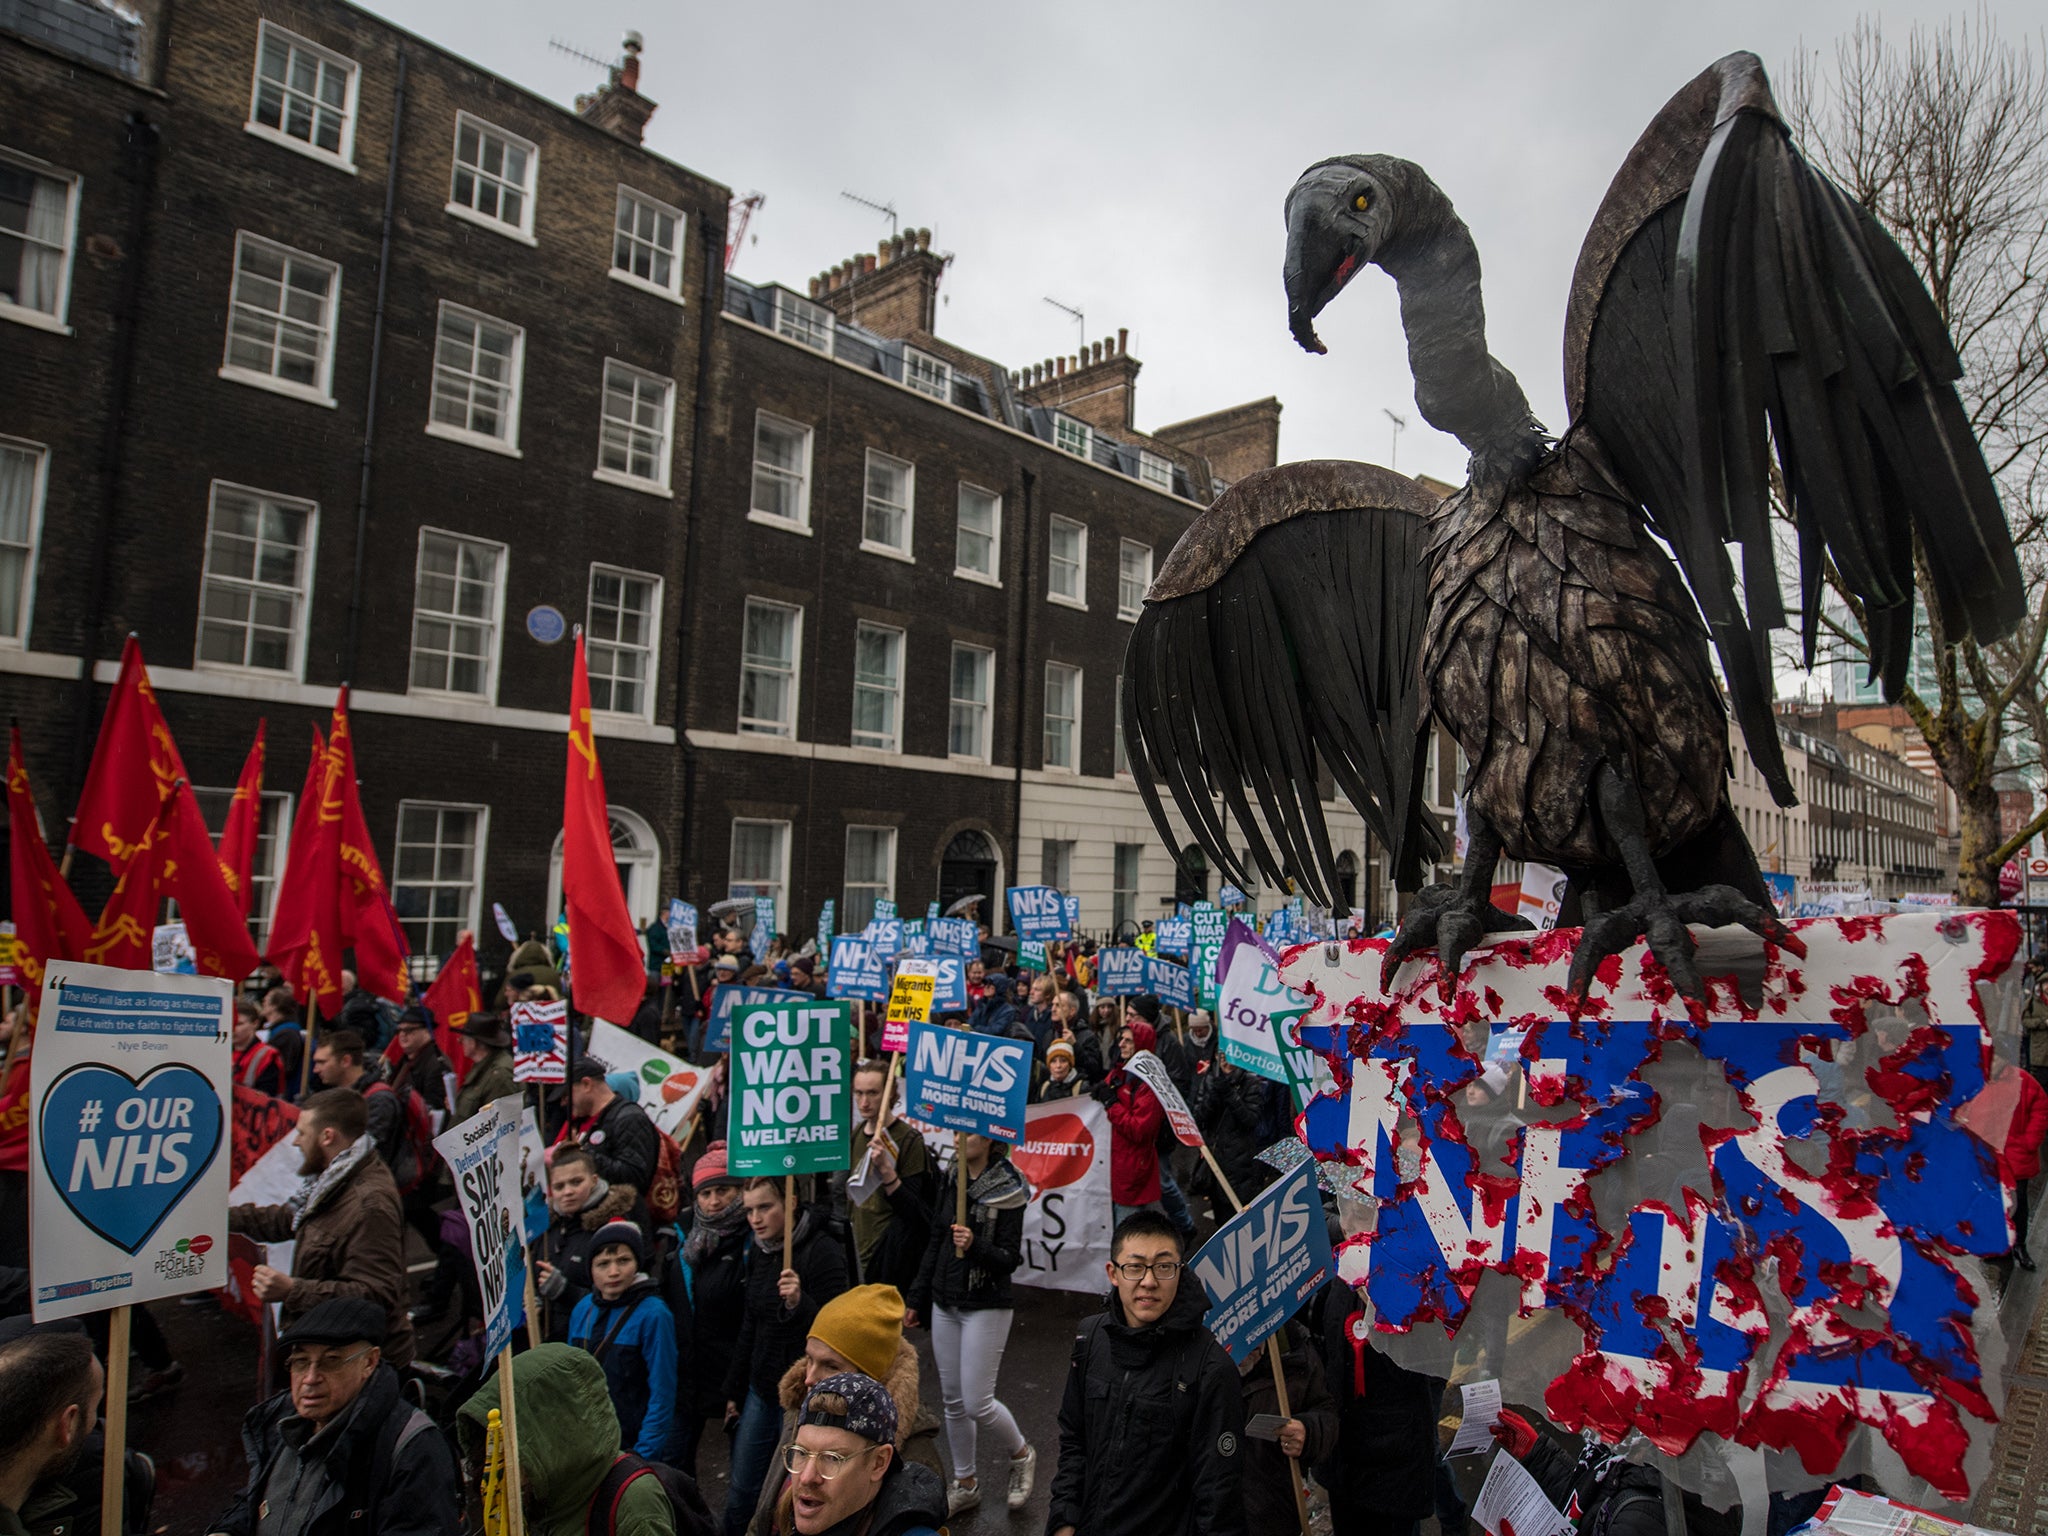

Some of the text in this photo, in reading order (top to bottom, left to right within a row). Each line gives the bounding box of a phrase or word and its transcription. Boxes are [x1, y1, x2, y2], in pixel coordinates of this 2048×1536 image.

[1013, 888, 1060, 916] NHS
[1801, 885, 1839, 894] CAMDEN
[670, 902, 697, 925] NHS
[875, 900, 896, 912] CUT
[1194, 912, 1224, 925] CUT
[1158, 922, 1192, 938] NHS
[1194, 924, 1225, 936] WAR
[833, 942, 883, 972] NHS
[1102, 950, 1144, 973] NHS
[896, 977, 932, 994] Migrants
[1148, 961, 1190, 992] NHS
[63, 991, 80, 1002] The
[80, 992, 98, 1004] NHS
[98, 994, 113, 1004] will
[114, 994, 132, 1006] last
[134, 998, 146, 1007] as
[148, 997, 169, 1010] long
[170, 1000, 182, 1009] as
[182, 1000, 204, 1010] there
[892, 994, 912, 1005] make
[60, 1016, 76, 1027] folk
[77, 1017, 93, 1028] left
[94, 1019, 114, 1030] with
[116, 1019, 135, 1030] the
[137, 1019, 160, 1030] faith
[162, 1021, 172, 1031] to
[173, 1021, 194, 1034] fight
[195, 1022, 208, 1032] for
[890, 1006, 923, 1020] our NHS
[1224, 998, 1271, 1033] for
[742, 1008, 840, 1048] CUT
[118, 1042, 140, 1052] Nye
[142, 1042, 168, 1051] Bevan
[1225, 1042, 1285, 1075] Abortion
[740, 1047, 842, 1085] WAR
[913, 1031, 1024, 1093] NHS
[921, 1087, 1006, 1118] MORE FUNDS
[923, 1080, 941, 1091] MORE
[942, 1083, 962, 1094] STAFF
[966, 1089, 987, 1101] MORE
[78, 1098, 194, 1132] # OUR
[742, 1084, 842, 1126] NOT
[463, 1120, 492, 1146] Socialist
[944, 1116, 977, 1128] TOGETHER
[988, 1124, 1016, 1138] Mirror
[740, 1124, 838, 1147] WELFARE
[1015, 1140, 1092, 1156] AUSTERITY
[68, 1132, 193, 1192] NHS
[455, 1146, 482, 1174] Defend
[463, 1153, 500, 1220] SAVE
[1346, 1058, 1903, 1348] NHS
[476, 1202, 502, 1266] OUR
[1194, 1173, 1310, 1303] NHS
[154, 1254, 205, 1273] PEOPLE'S
[159, 1248, 176, 1260] THE
[90, 1275, 132, 1291] Together
[164, 1266, 204, 1281] ASSEMBLY
[482, 1247, 504, 1315] NHS
[1296, 1267, 1326, 1301] Mirror
[1210, 1243, 1308, 1332] MORE STAFF MORE BEDS
[1214, 1252, 1311, 1344] MORE FUNDS
[1246, 1310, 1285, 1344] TOGETHER
